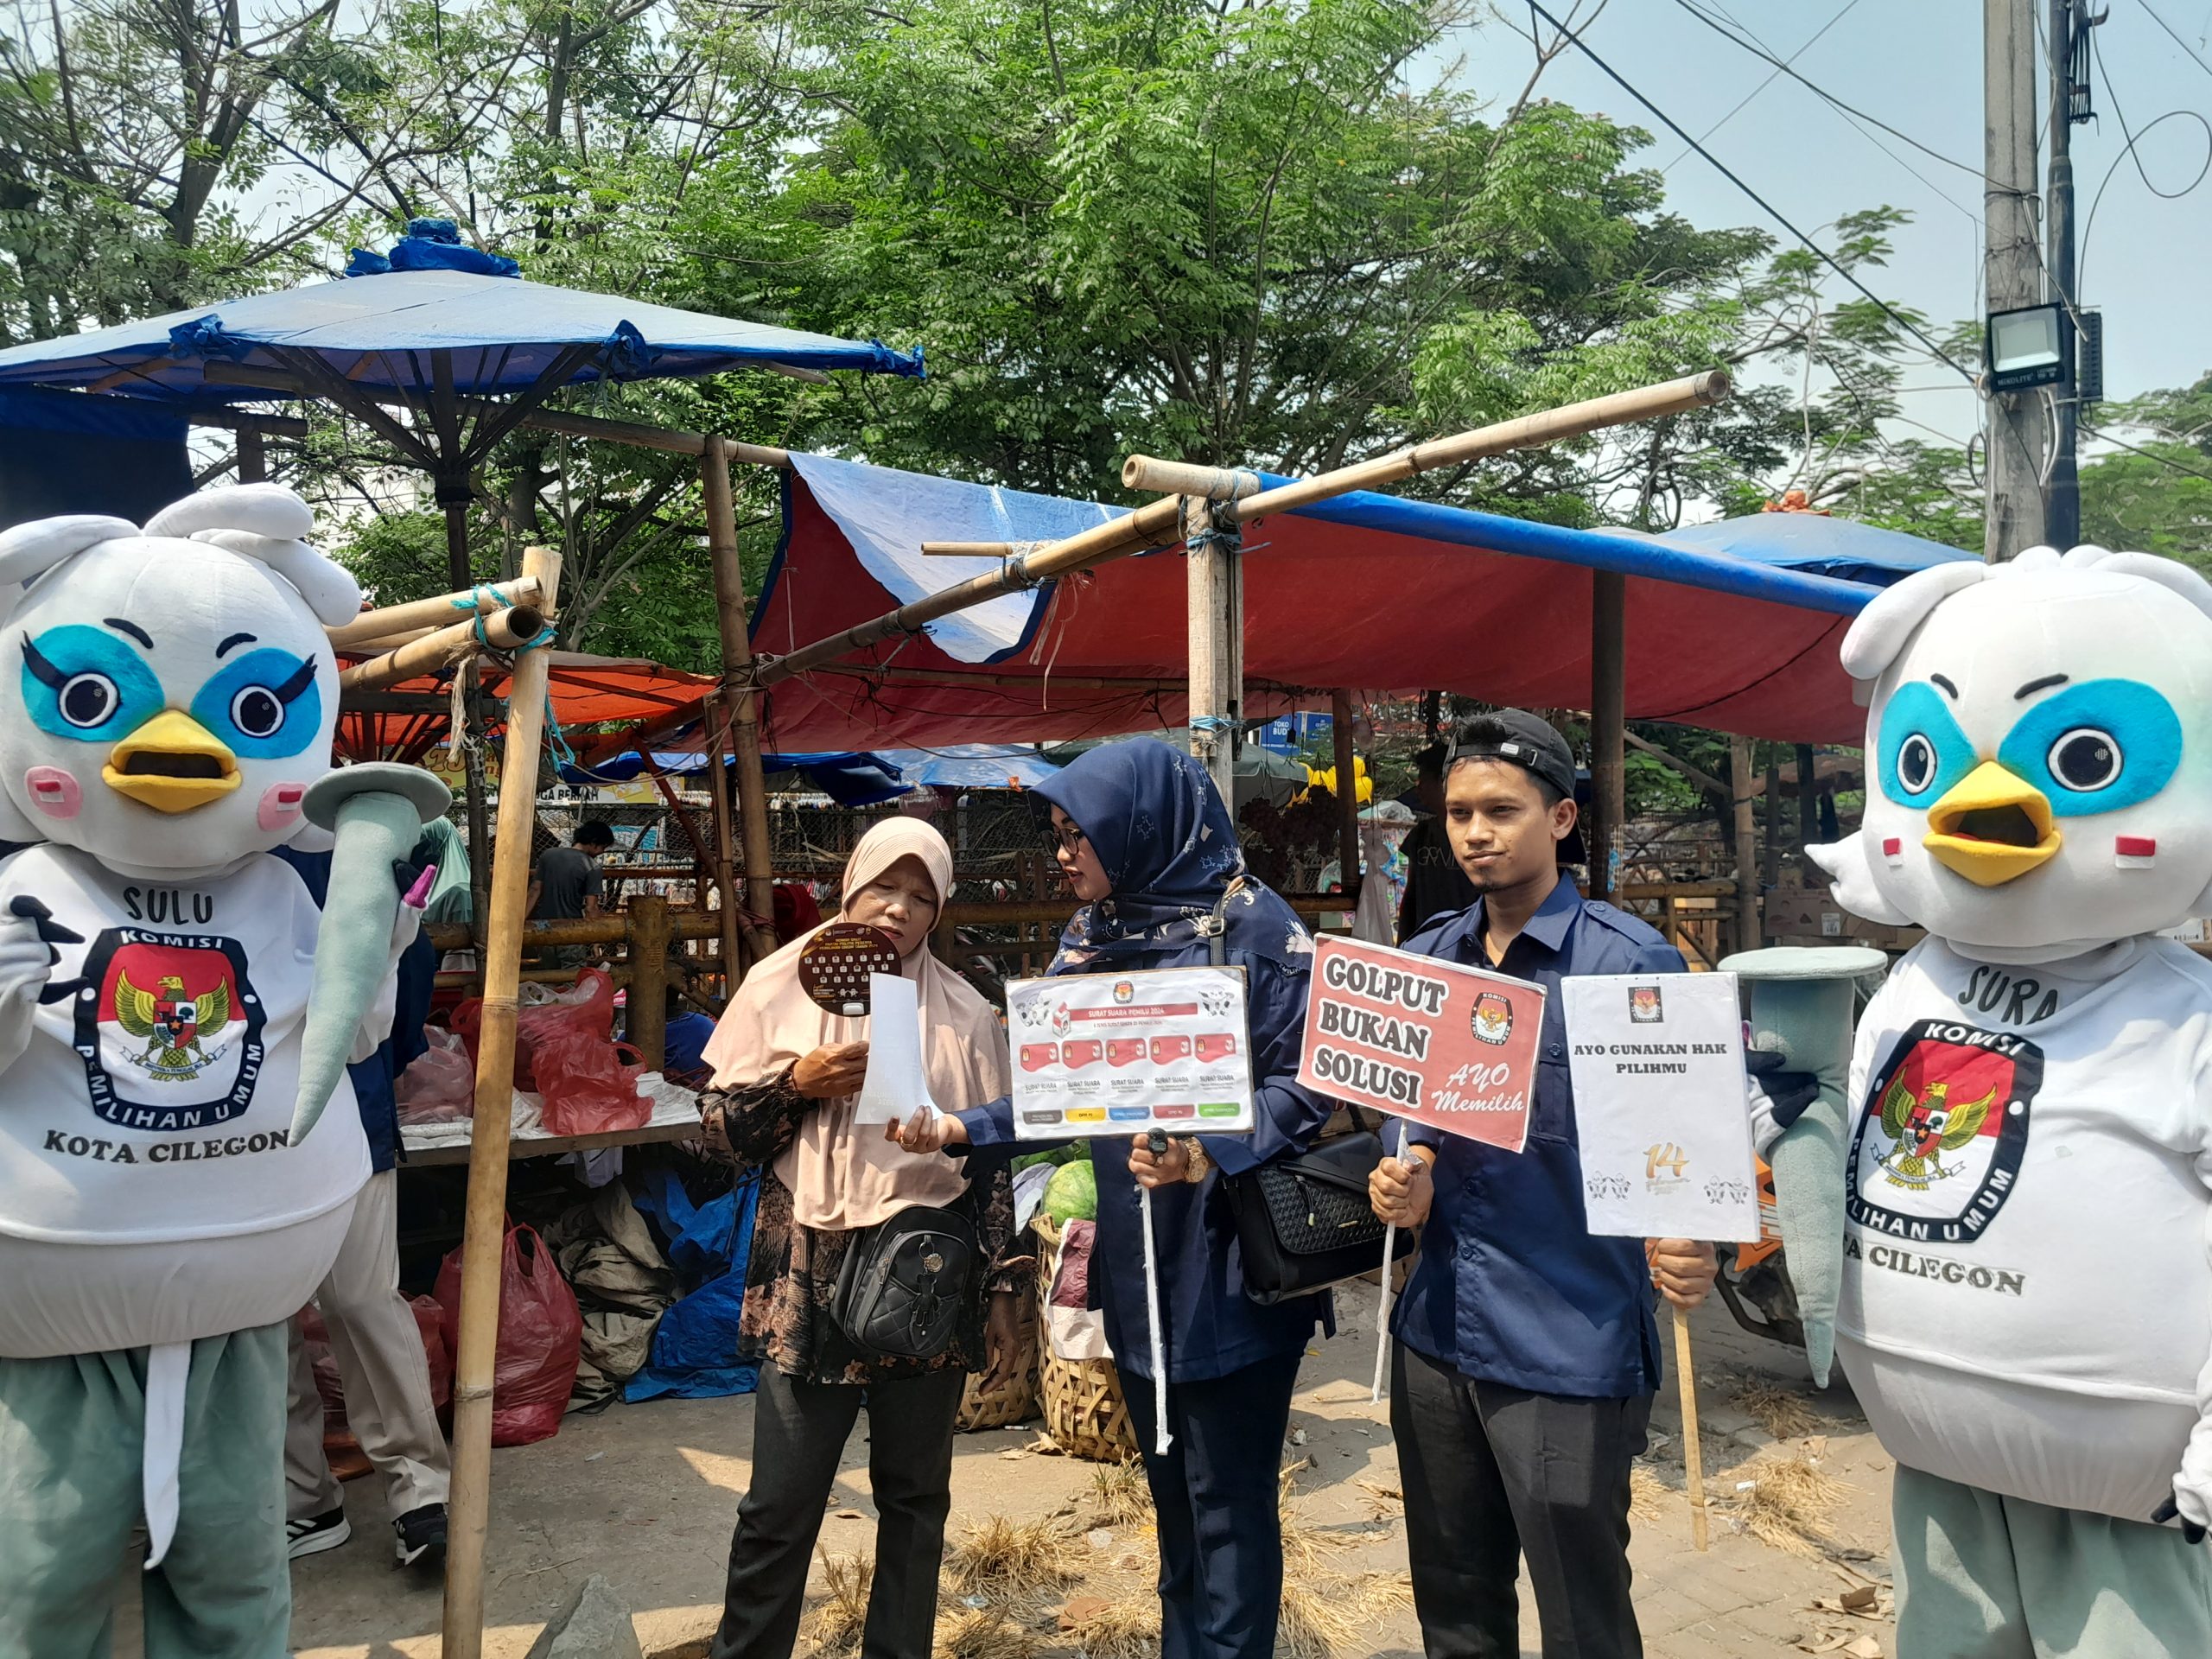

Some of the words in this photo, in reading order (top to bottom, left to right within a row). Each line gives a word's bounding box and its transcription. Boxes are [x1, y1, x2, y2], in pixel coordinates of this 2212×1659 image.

[124, 887, 213, 925] SULU
[120, 930, 223, 949] KOMISI
[1326, 957, 1446, 1014] GOLPUT
[1483, 993, 1507, 1002] KOMISI
[1958, 965, 2058, 1026] SURA
[1320, 1001, 1428, 1059] BUKAN
[1923, 1023, 2025, 1057] KOMISI
[1573, 1044, 1605, 1055] AYO
[1609, 1044, 1688, 1055] GUNAKAN
[1692, 1043, 1727, 1054] HAK
[76, 1045, 200, 1128] PEMILIHAN
[214, 1044, 262, 1120] UMUM
[1315, 1048, 1421, 1105] SOLUSI
[1446, 1063, 1510, 1093] AYO
[1616, 1064, 1687, 1074] PILIHMU
[1431, 1090, 1525, 1112] Memilih
[43, 1129, 140, 1164] KOTA
[148, 1128, 290, 1162] CILEGON
[1643, 1142, 1690, 1179] 14
[1845, 1137, 1929, 1241] PEMILIHAN
[1943, 1169, 2013, 1241] UMUM
[1869, 1245, 2027, 1296] CILEGON
